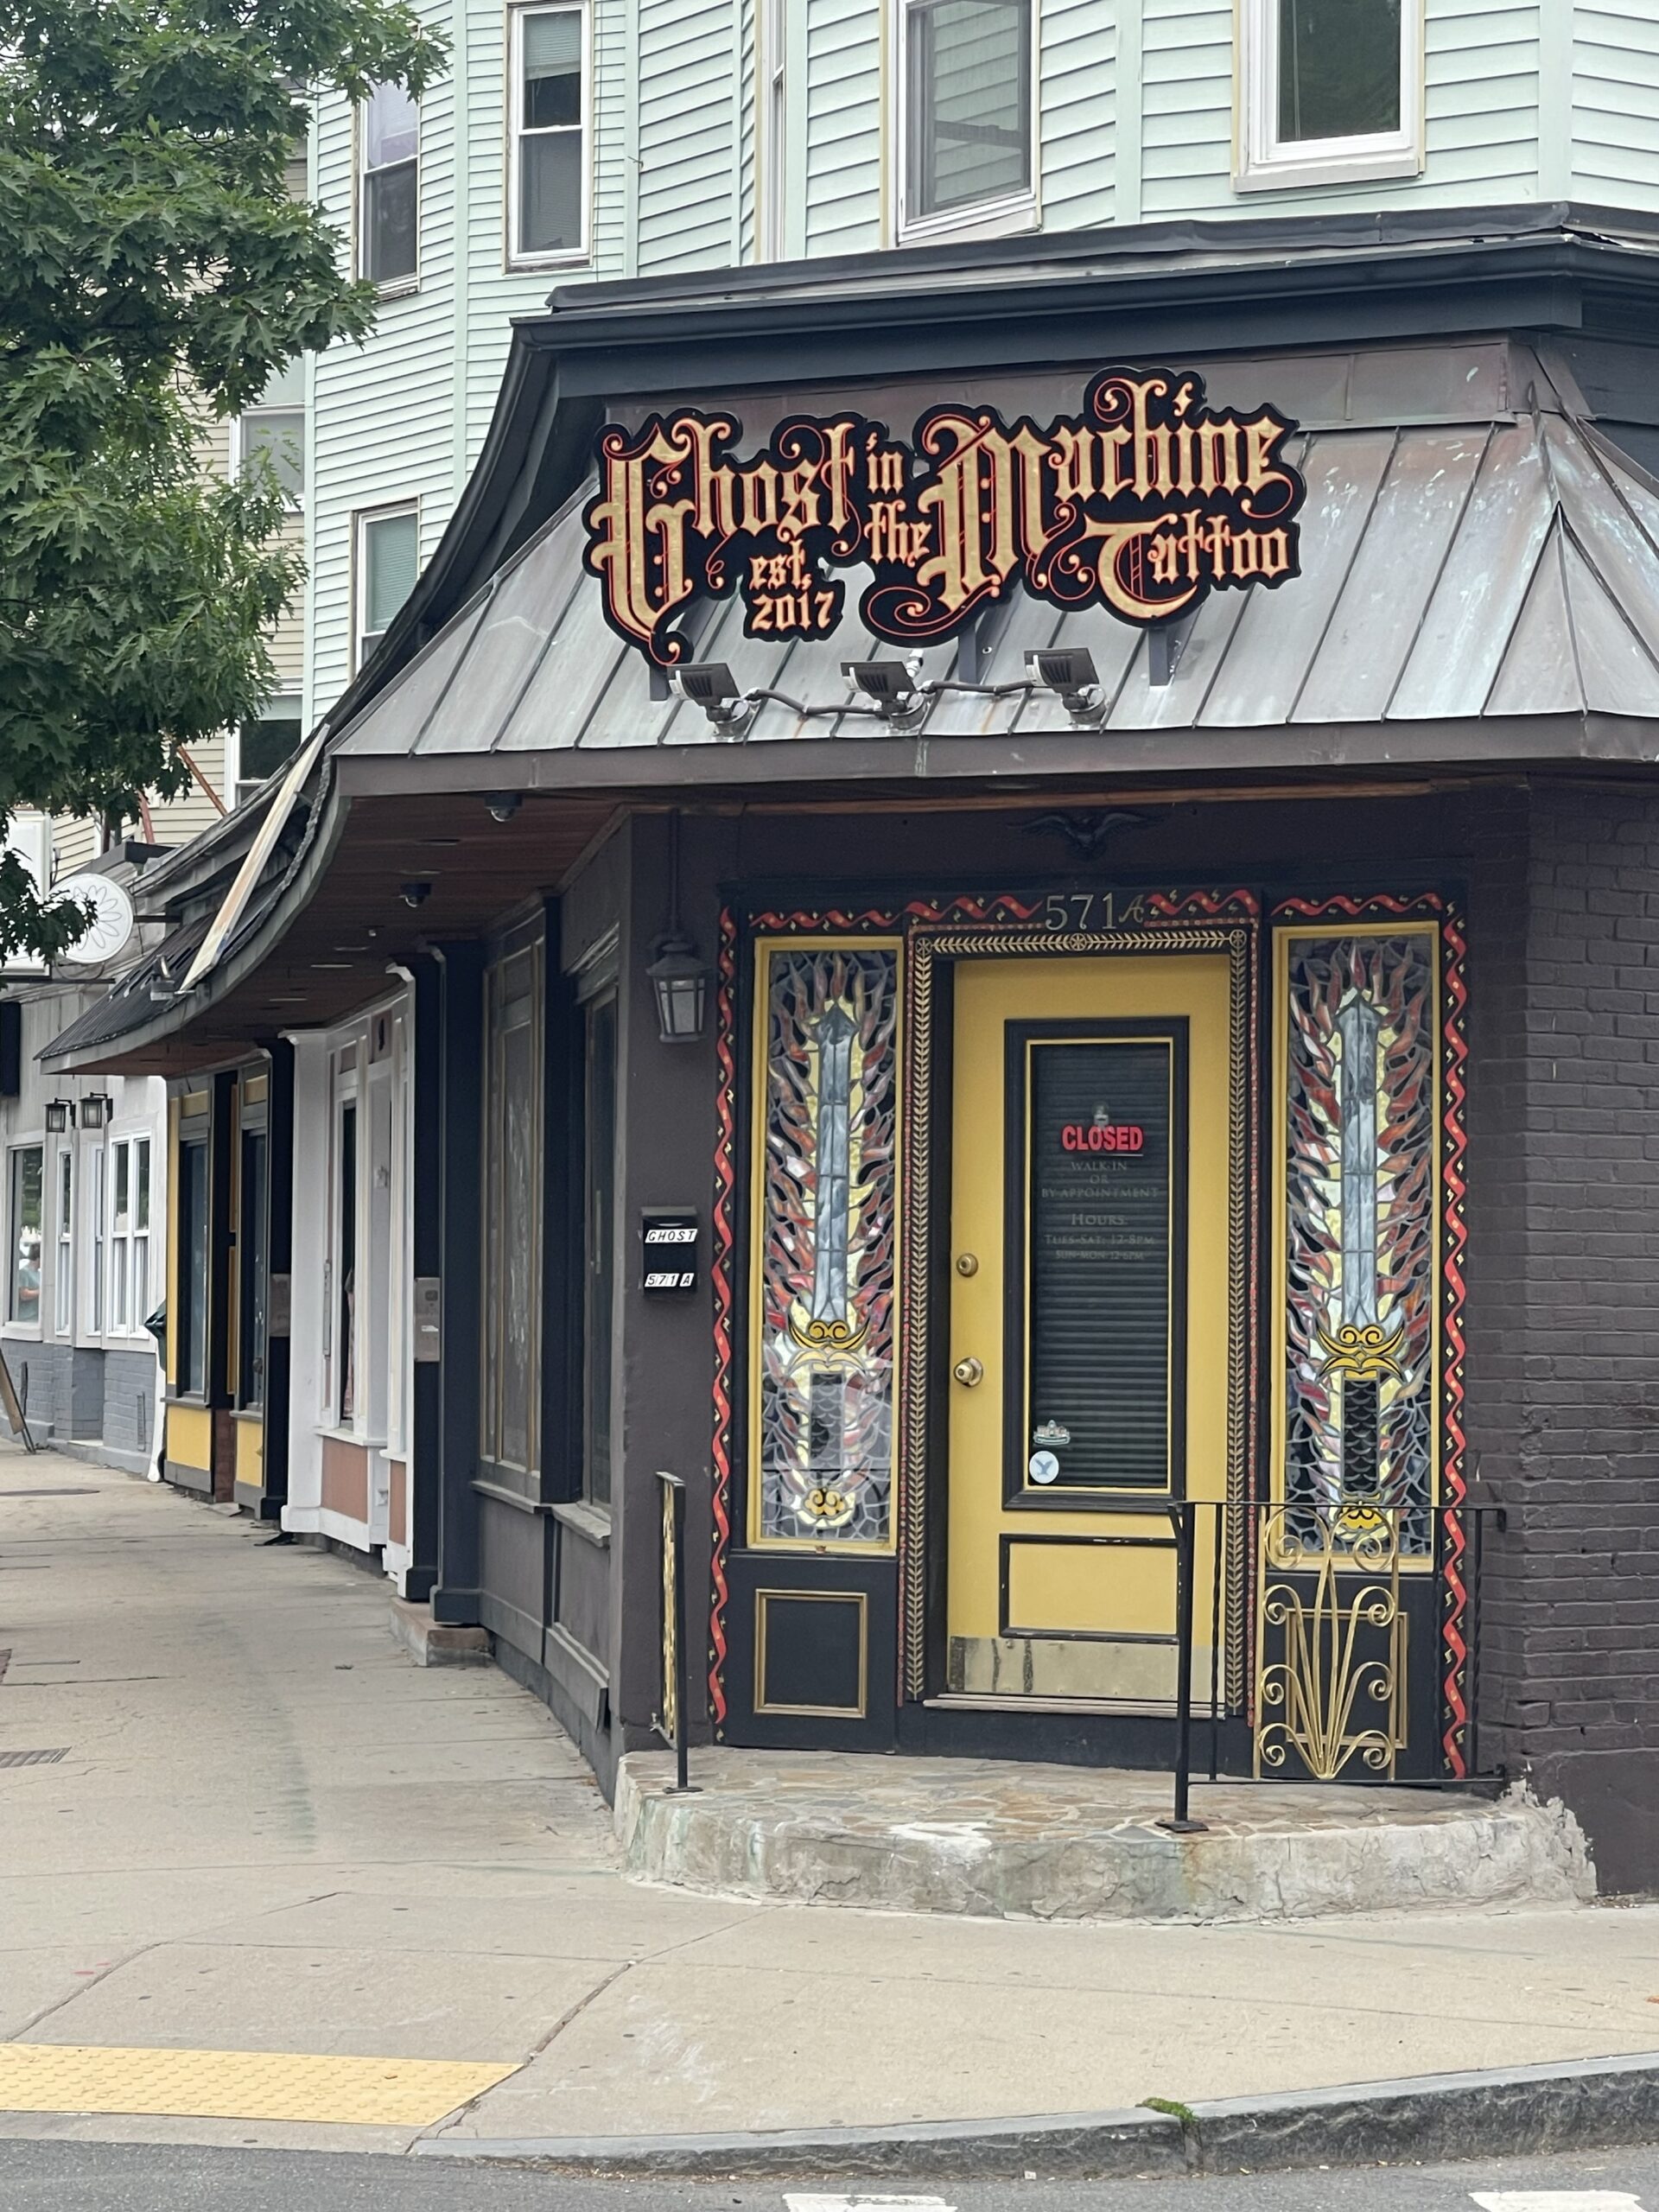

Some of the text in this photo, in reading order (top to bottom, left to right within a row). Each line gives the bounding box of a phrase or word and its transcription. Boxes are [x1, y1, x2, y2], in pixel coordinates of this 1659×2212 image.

[591, 378, 1296, 657] Ghost in the Machine
[1076, 508, 1292, 620] Tattoo
[751, 590, 835, 632] 2017
[1062, 1126, 1143, 1150] CLOSED
[1089, 1174, 1109, 1185] OR
[1041, 1187, 1160, 1198] BY APPOINTMENT
[648, 1230, 696, 1242] GHOST
